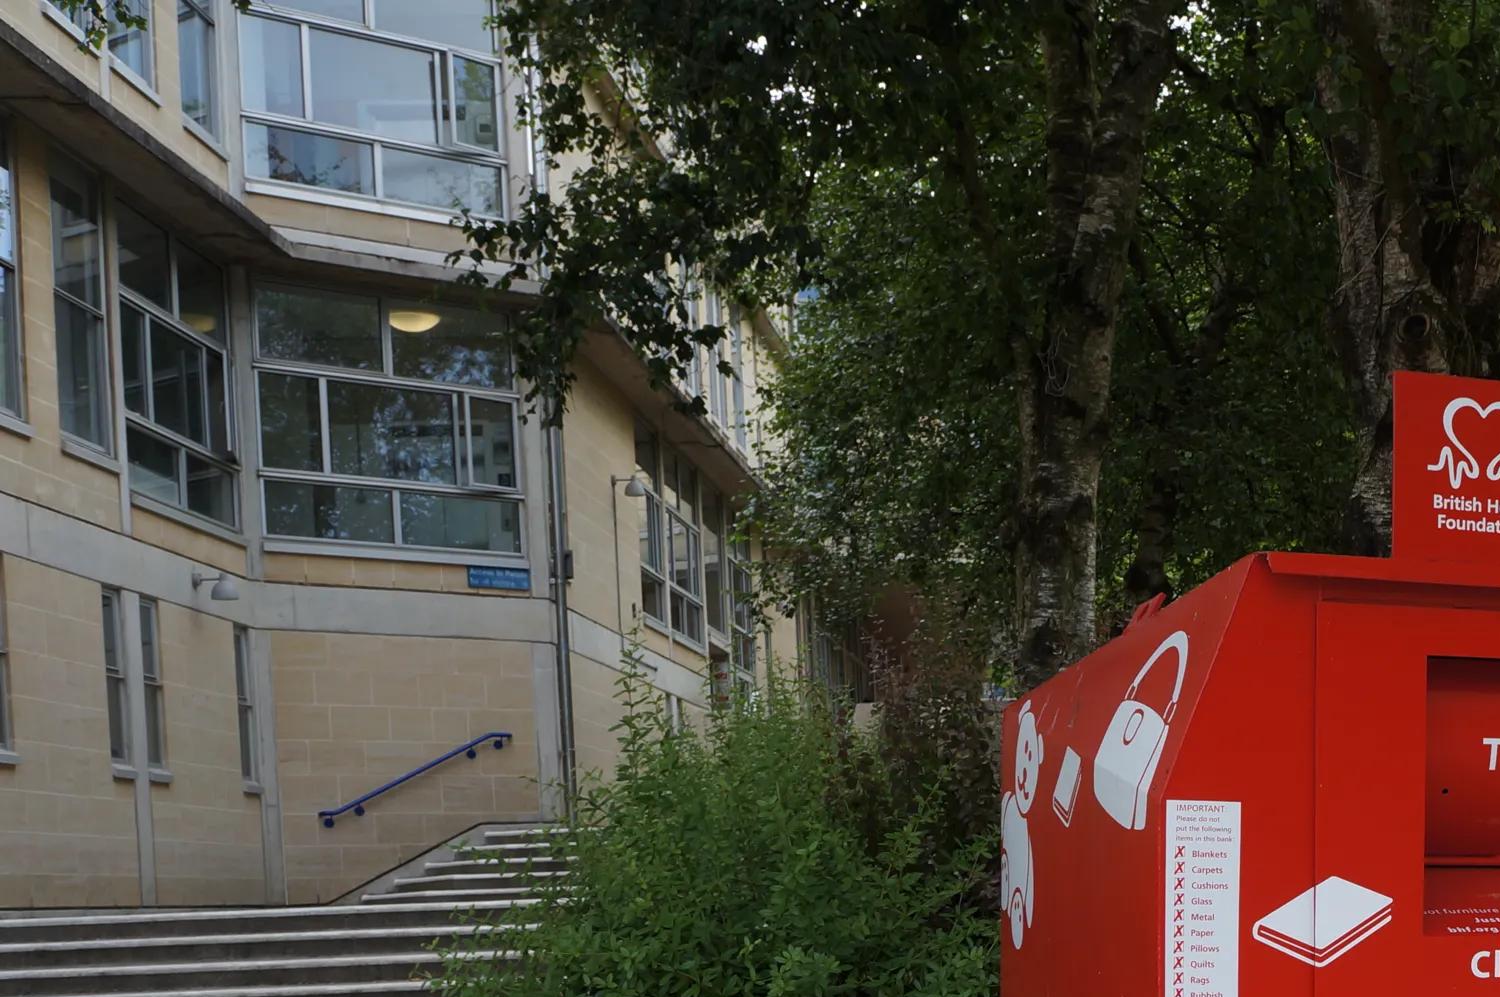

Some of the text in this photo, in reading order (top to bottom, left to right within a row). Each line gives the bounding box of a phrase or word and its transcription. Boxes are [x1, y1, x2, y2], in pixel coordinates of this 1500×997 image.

[1434, 494, 1481, 512] British
[1192, 850, 1227, 859] Blankets
[1192, 866, 1223, 875] Carpets
[1192, 881, 1228, 890] Cushions
[1191, 897, 1212, 905] Glass
[1191, 913, 1215, 921] Metal
[1191, 929, 1214, 937] Paper
[1190, 976, 1210, 984] Rags
